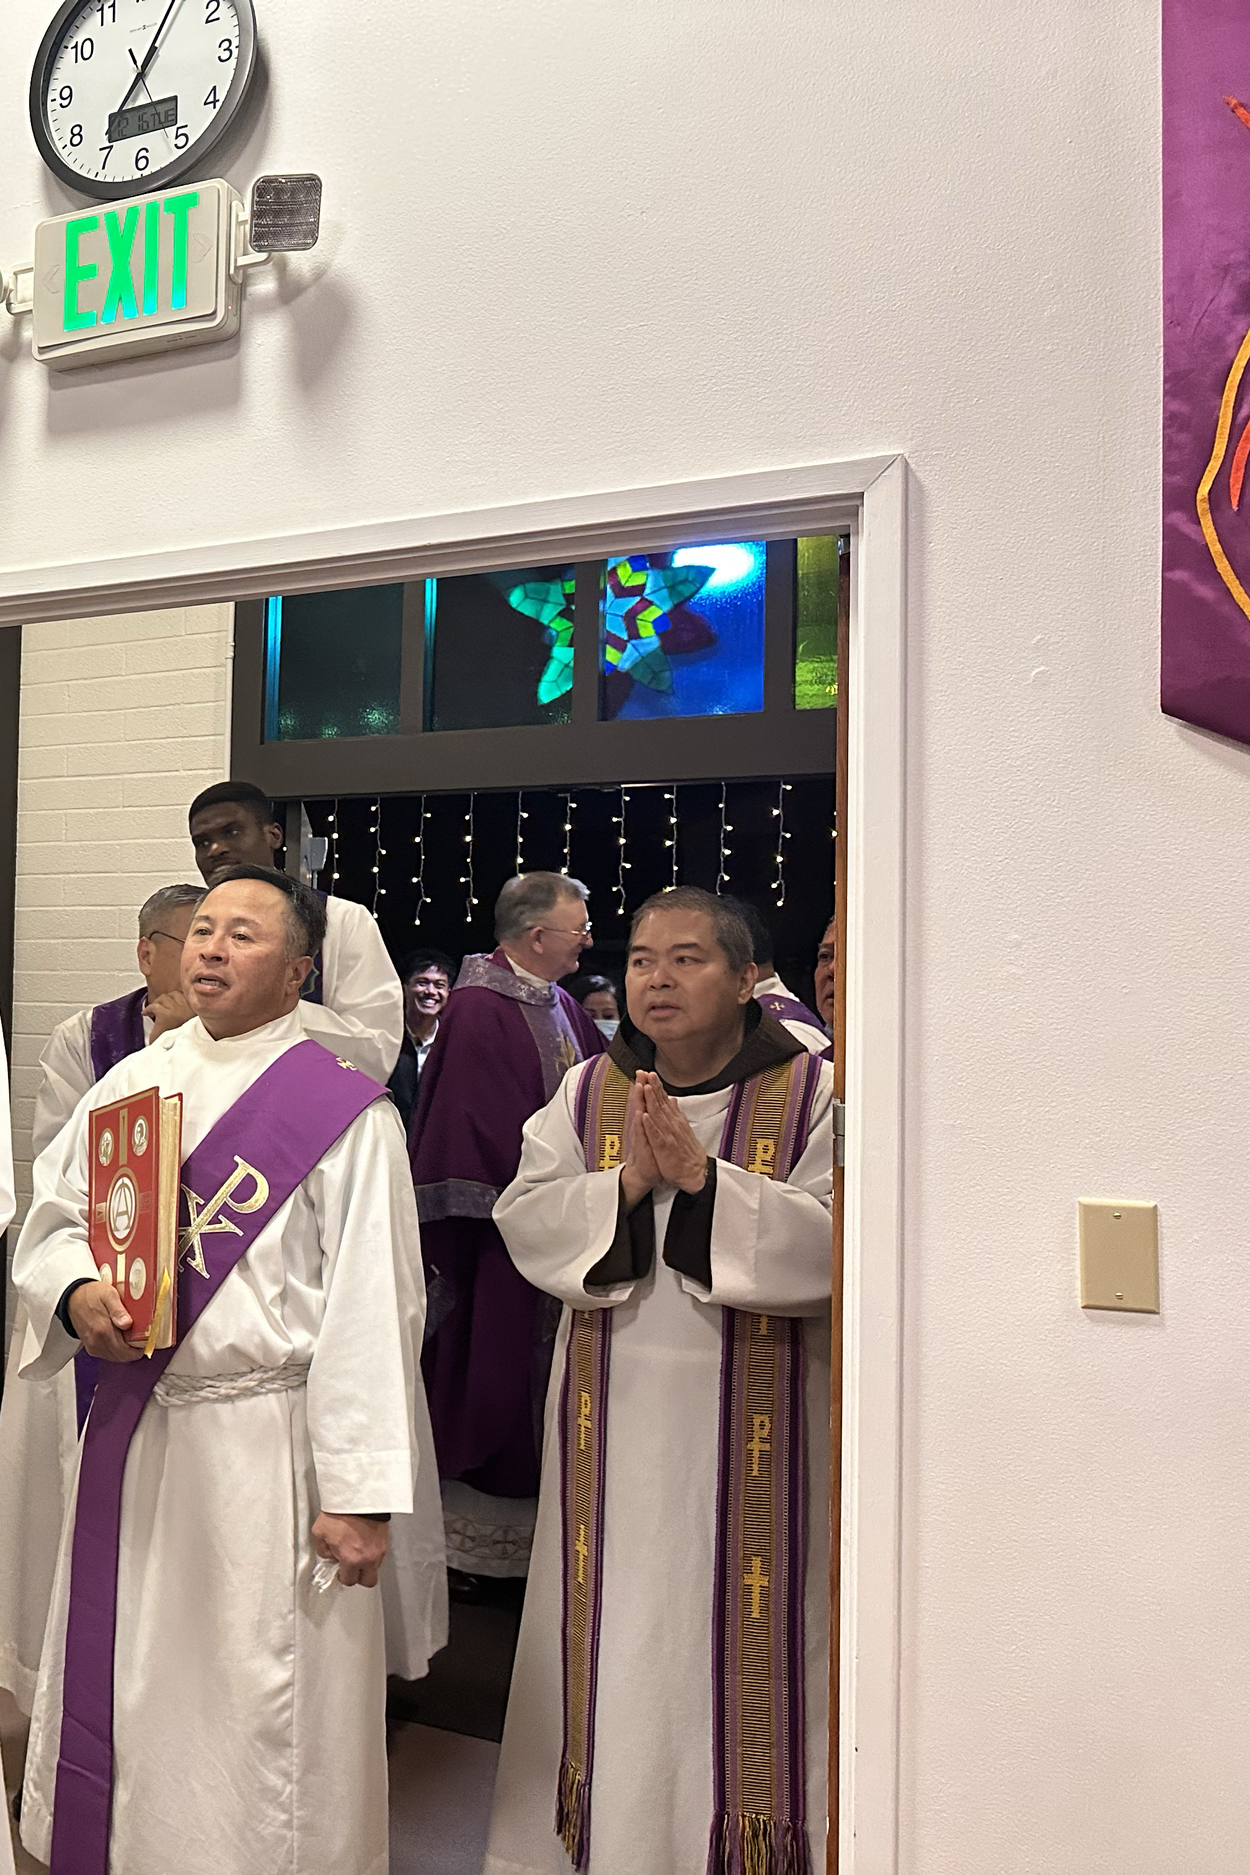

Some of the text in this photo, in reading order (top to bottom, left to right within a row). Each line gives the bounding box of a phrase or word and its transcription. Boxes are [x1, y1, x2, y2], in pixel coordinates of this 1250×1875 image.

[96, 0, 116, 27] 11
[205, 0, 221, 24] 2
[70, 38, 95, 64] 10
[217, 38, 234, 63] 3
[58, 85, 74, 109] 9
[203, 85, 220, 110] 4
[150, 107, 176, 127] TUE
[69, 123, 84, 148] 8
[174, 124, 190, 150] 5
[99, 145, 114, 170] 7
[134, 147, 150, 172] 6
[63, 191, 199, 332] EXIT
